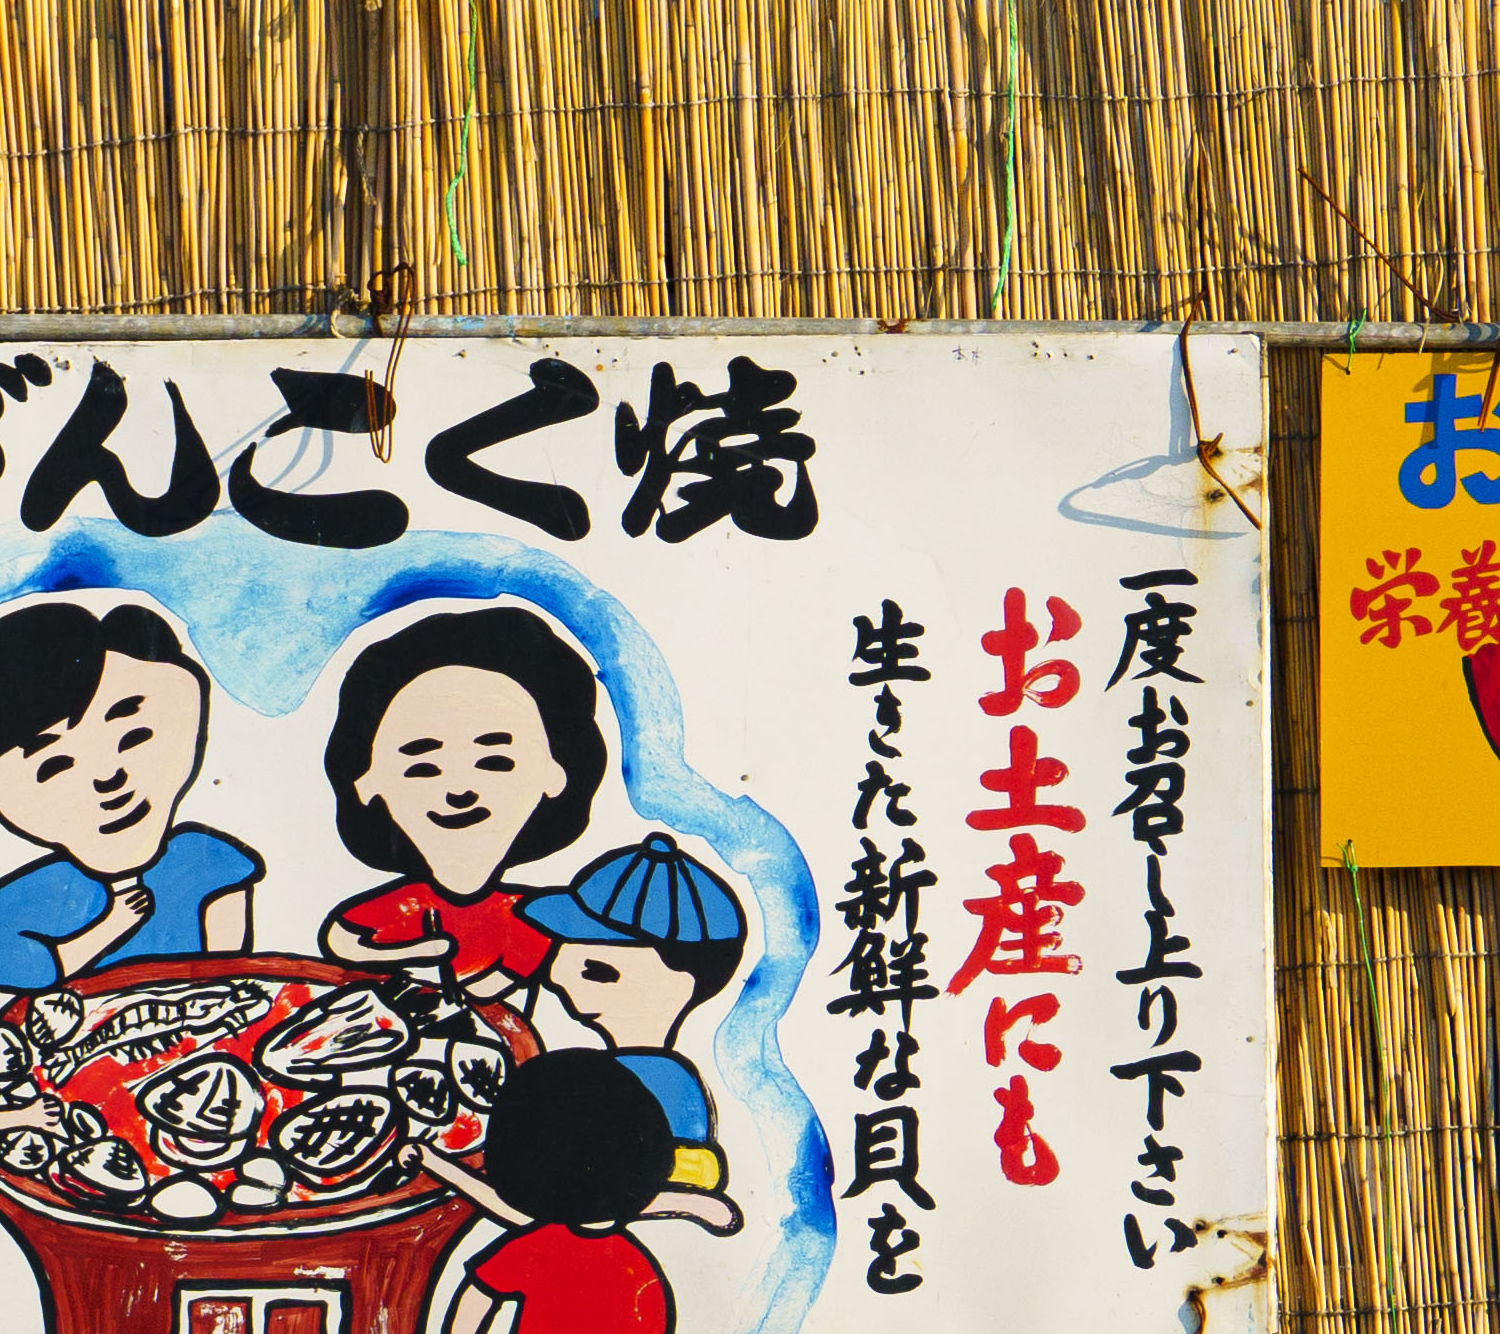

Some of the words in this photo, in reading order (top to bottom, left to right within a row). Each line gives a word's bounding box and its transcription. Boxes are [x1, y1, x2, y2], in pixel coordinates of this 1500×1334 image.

[1399, 375, 1500, 508] お
[827, 600, 939, 1294] 生きた新鮮な貝を
[947, 588, 1086, 1185] お土産にも
[1106, 569, 1205, 1269] 一度お召し上り下さい
